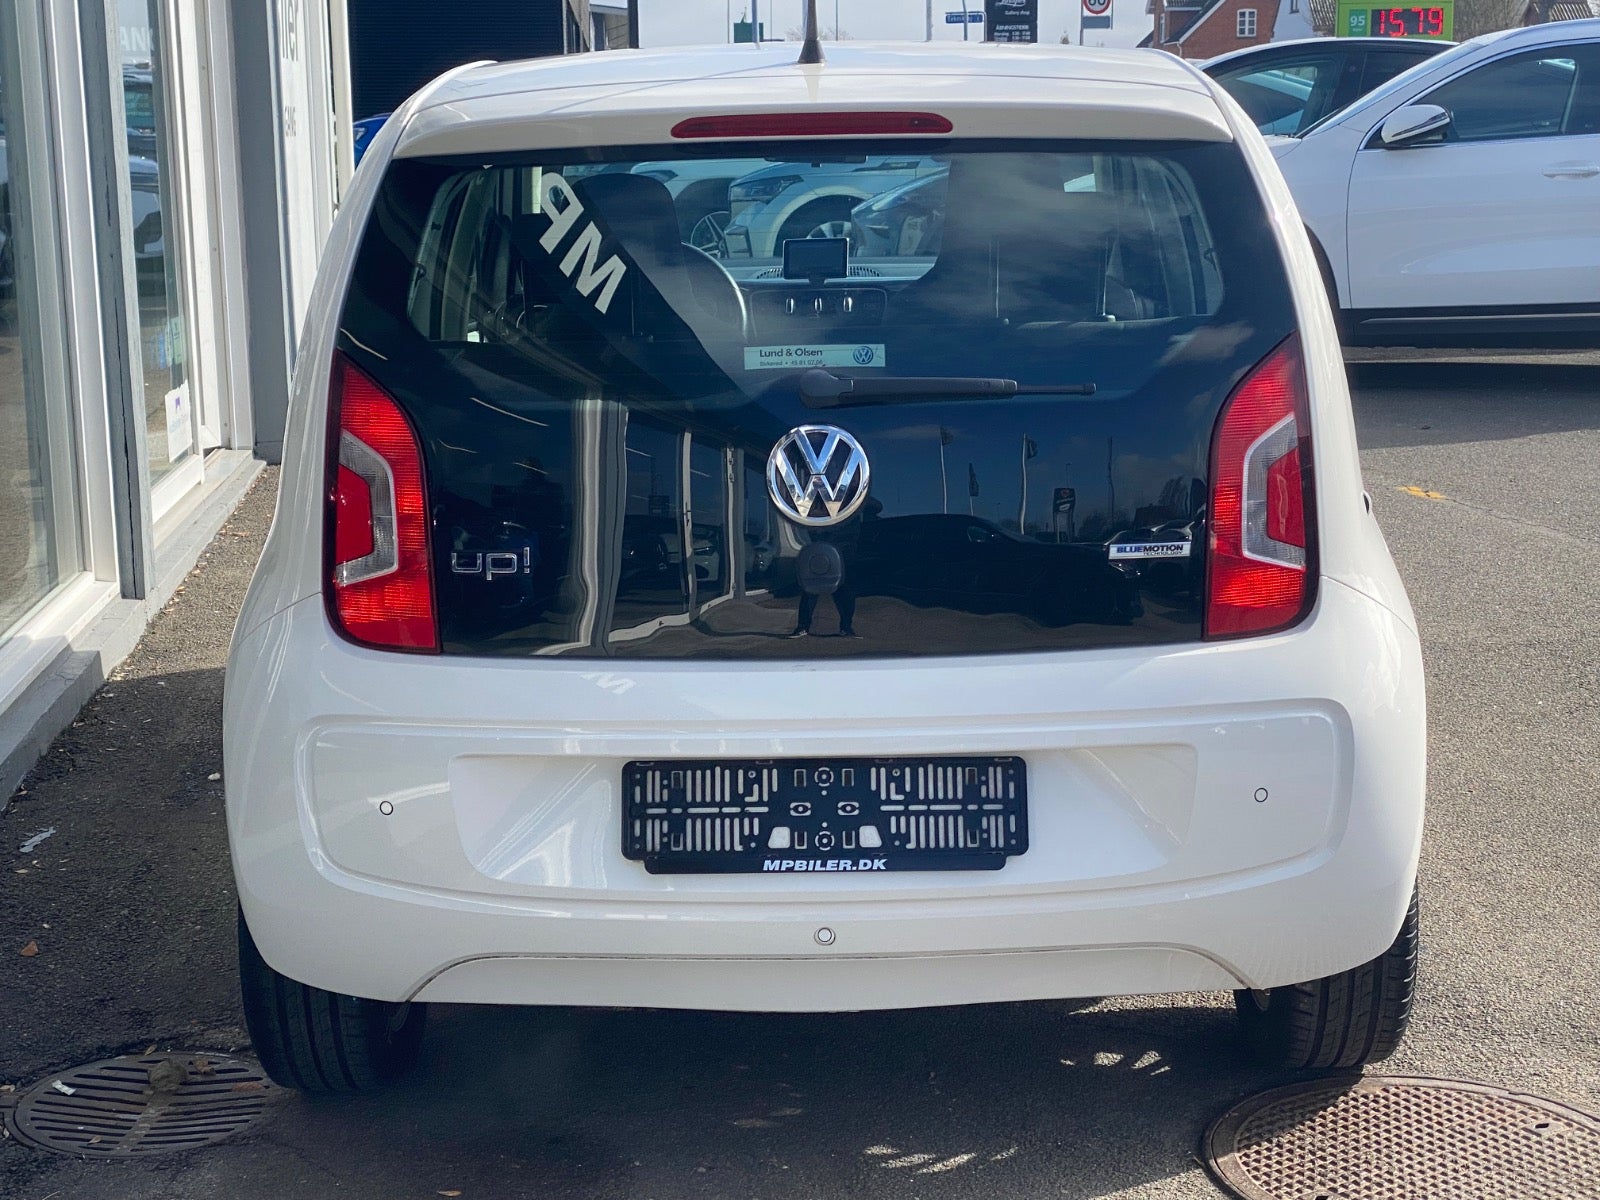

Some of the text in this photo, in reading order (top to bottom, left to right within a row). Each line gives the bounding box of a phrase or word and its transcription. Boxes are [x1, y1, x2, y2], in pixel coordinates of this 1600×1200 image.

[1350, 15, 1366, 27] 95
[759, 347, 823, 358] Lund & Olsen
[1116, 544, 1184, 554] BLUEMOTION
[451, 546, 530, 581] up!
[762, 858, 888, 872] MPBILER.DK
